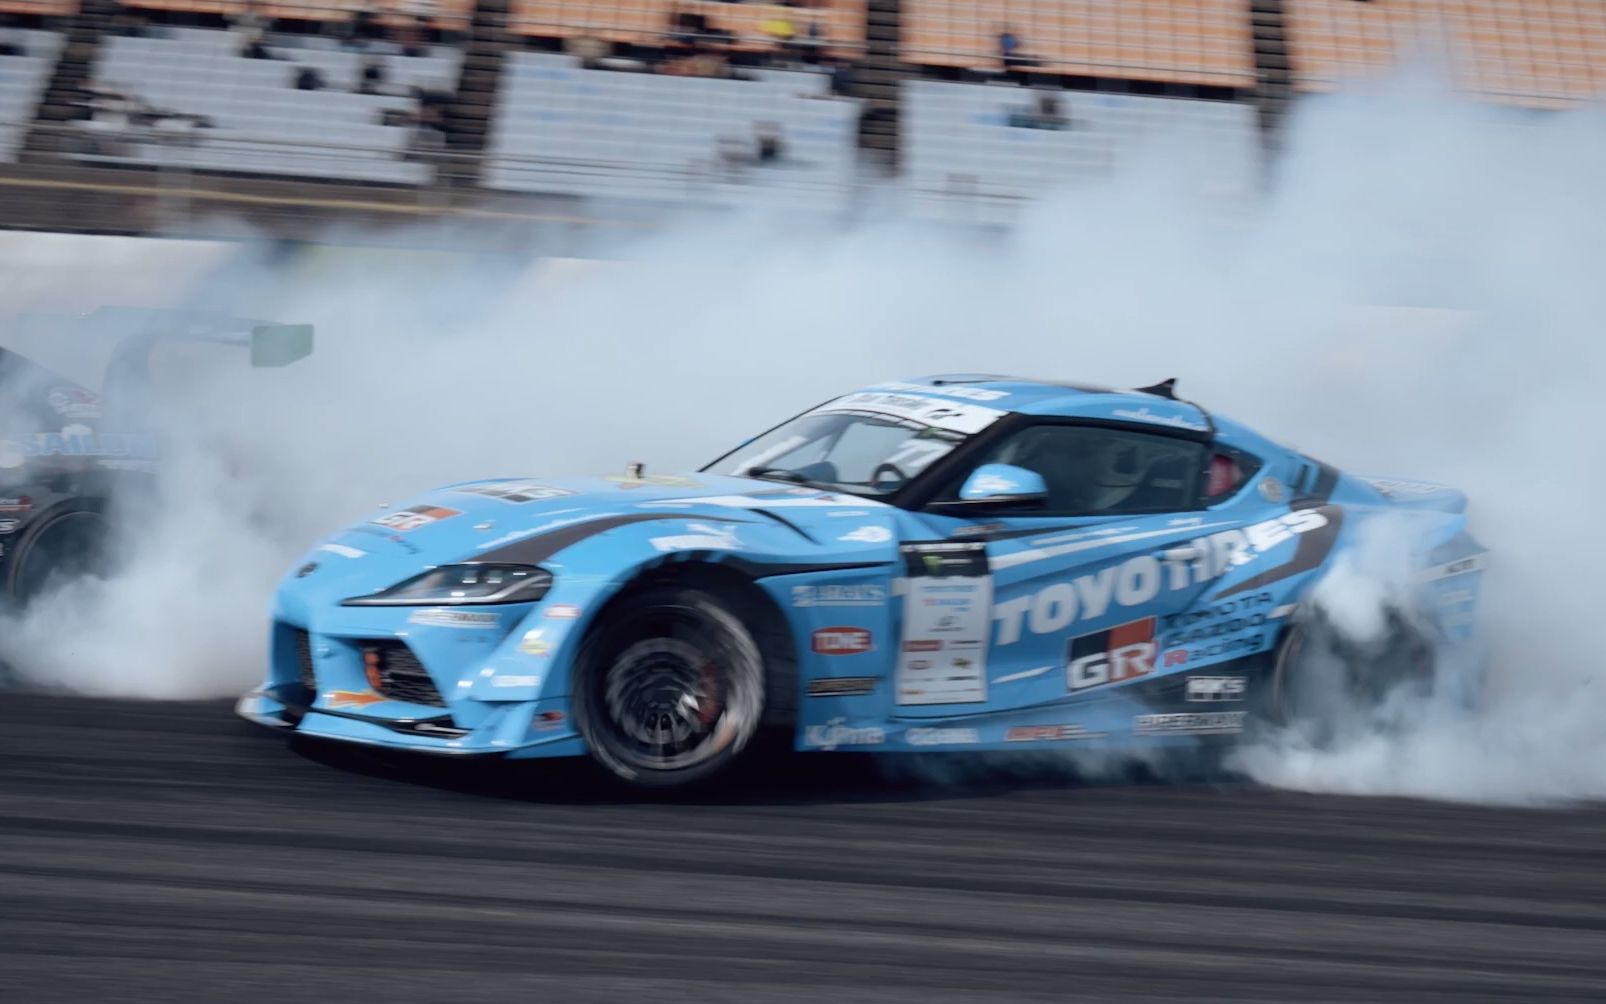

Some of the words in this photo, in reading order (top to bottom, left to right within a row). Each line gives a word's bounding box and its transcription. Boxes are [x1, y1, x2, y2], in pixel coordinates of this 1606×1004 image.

[992, 555, 1161, 645] TOYO
[1163, 509, 1328, 591] TIRES
[1161, 592, 1271, 627] TOYOTA
[1166, 612, 1266, 646] GAZOO
[1066, 642, 1158, 689] GR
[1163, 633, 1264, 667] Racing
